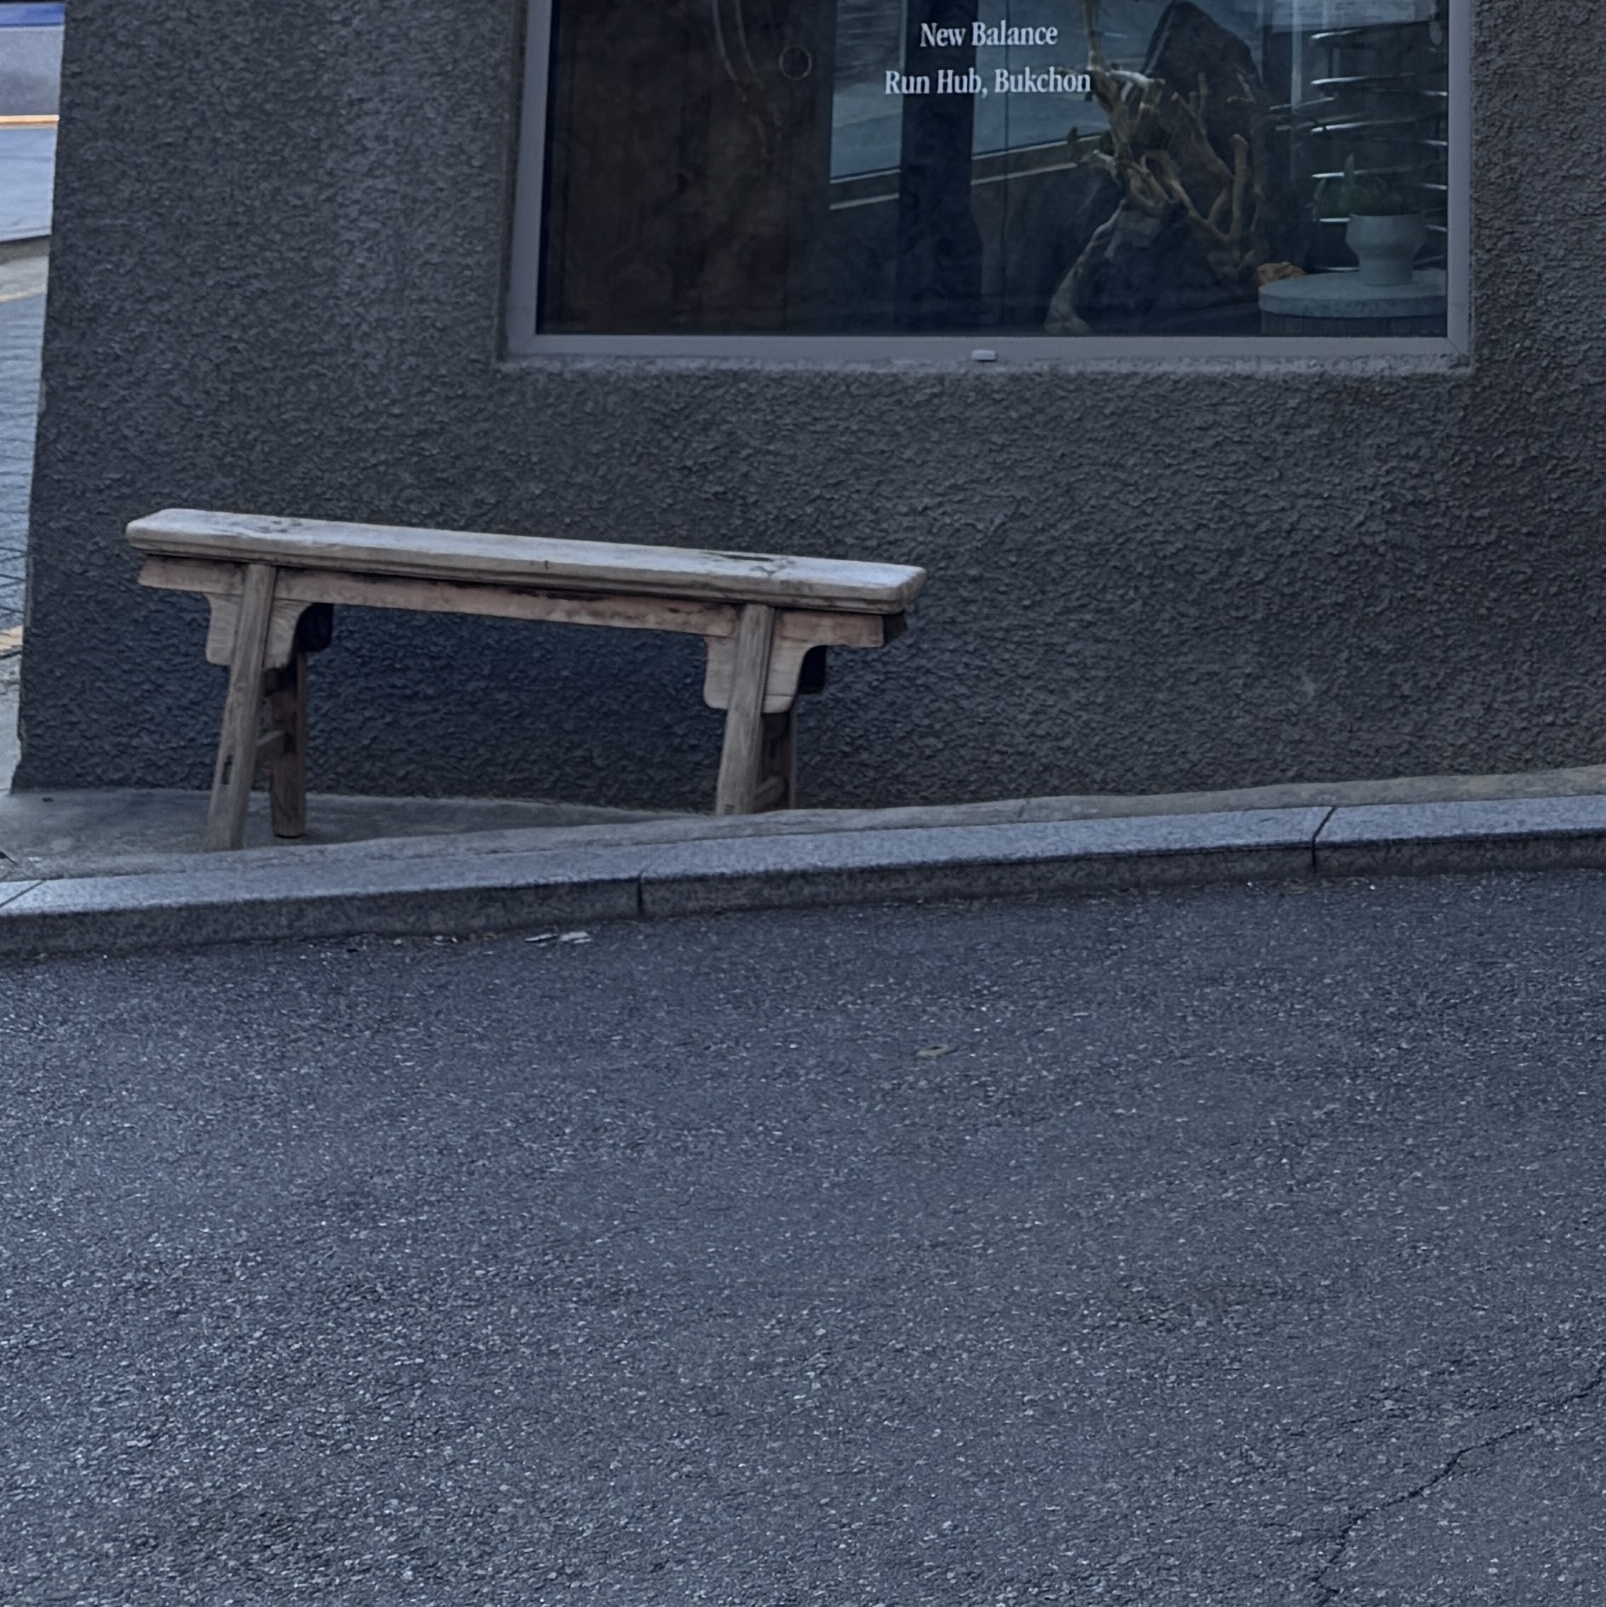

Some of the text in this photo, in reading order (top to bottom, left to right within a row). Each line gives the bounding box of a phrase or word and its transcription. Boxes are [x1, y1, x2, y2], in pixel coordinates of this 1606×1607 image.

[919, 19, 1059, 48] New Balance
[884, 66, 1092, 98] Run Hub, Bukchon
